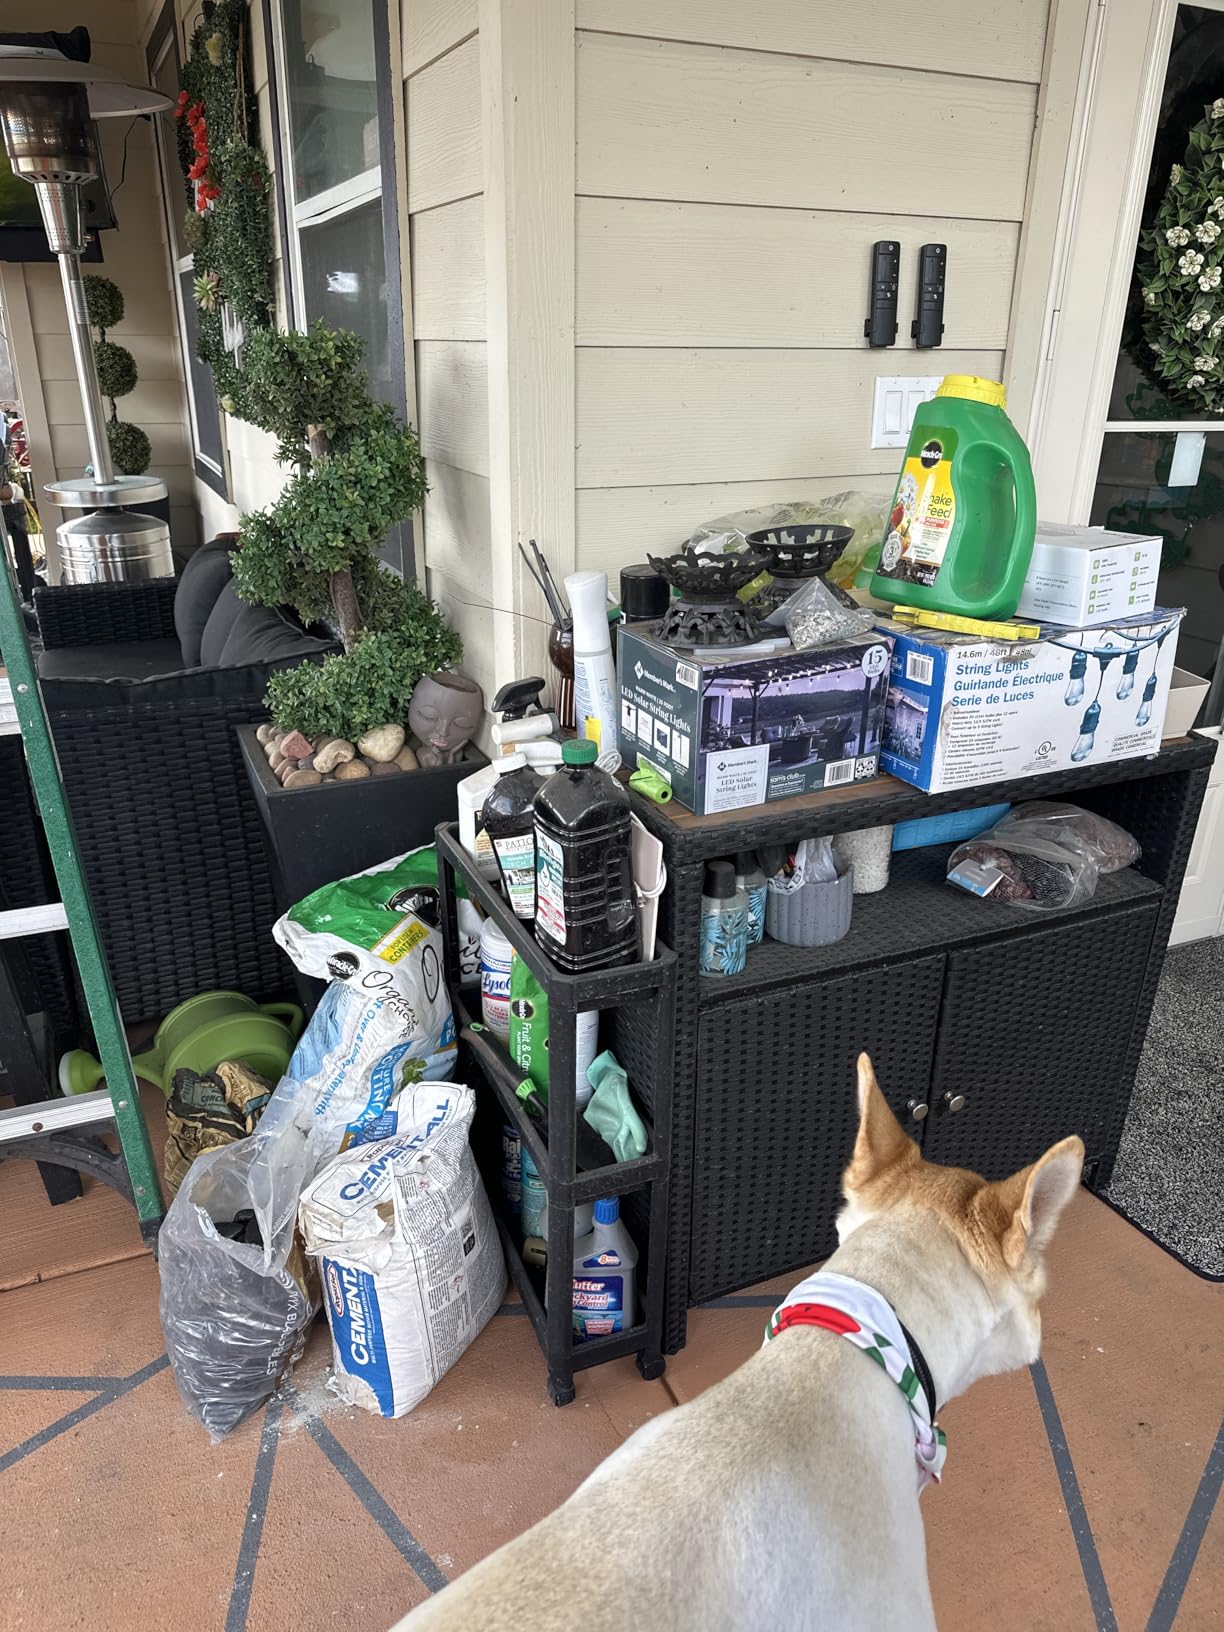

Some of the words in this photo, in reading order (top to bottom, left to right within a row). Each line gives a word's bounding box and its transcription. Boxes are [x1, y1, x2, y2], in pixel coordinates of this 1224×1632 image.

[930, 494, 953, 507] hake
[867, 650, 883, 665] 15
[957, 650, 983, 659] 14.6m
[956, 664, 993, 675] String
[996, 660, 1030, 674] Lights
[954, 678, 1009, 691] Guirlande
[1012, 672, 1064, 687] Électrique
[951, 696, 982, 706] Serie
[986, 693, 1000, 704] de
[1004, 691, 1035, 702] Luces
[621, 684, 633, 699] LED
[634, 692, 649, 709] Solar
[649, 702, 669, 723] String
[669, 713, 691, 733] Lights
[716, 784, 736, 793] String
[737, 781, 757, 791] Lights
[483, 972, 511, 993] Lysol
[360, 1009, 376, 1033] Over
[521, 1022, 532, 1041] Fruit
[521, 1042, 531, 1052] &
[342, 1043, 361, 1069] Under
[521, 1054, 532, 1075] Citru
[503, 1135, 520, 1154] Rai
[573, 1292, 609, 1301] ckyard
